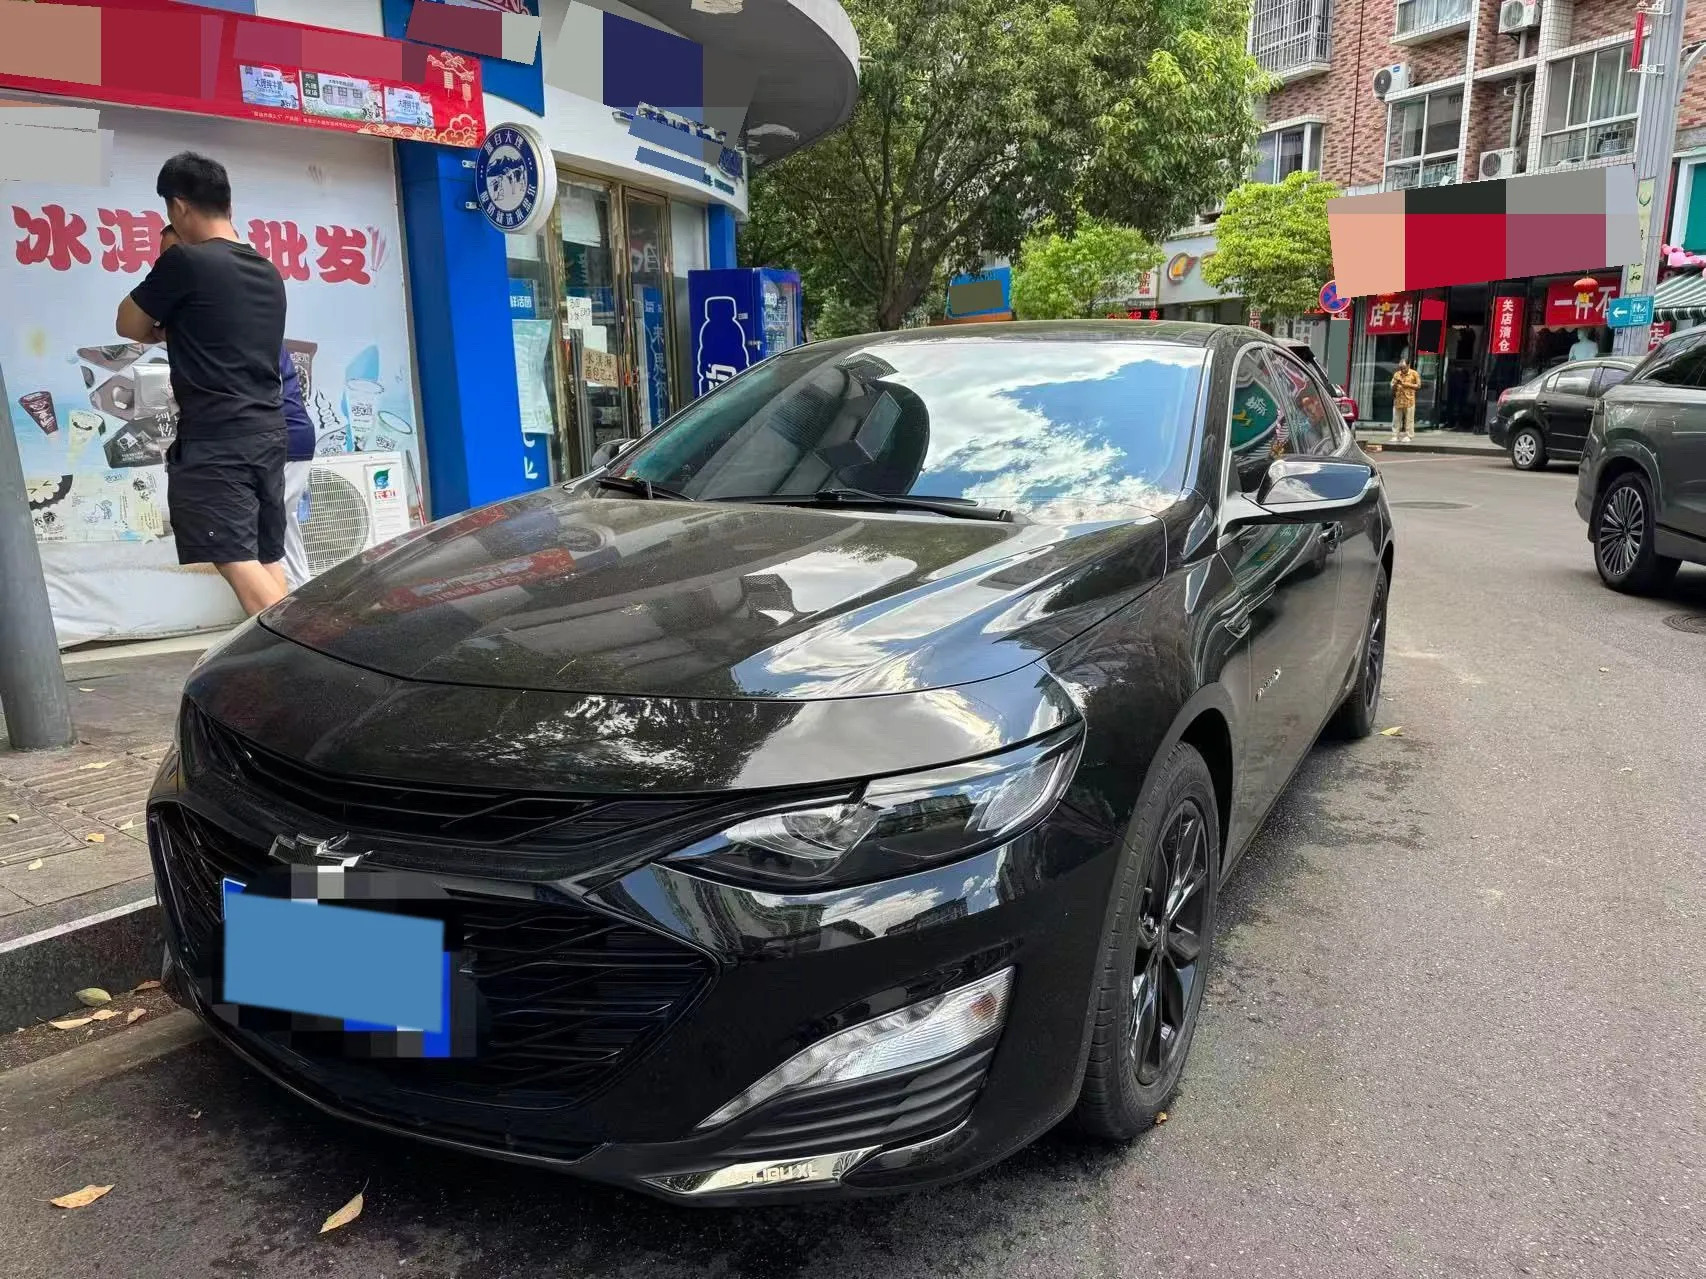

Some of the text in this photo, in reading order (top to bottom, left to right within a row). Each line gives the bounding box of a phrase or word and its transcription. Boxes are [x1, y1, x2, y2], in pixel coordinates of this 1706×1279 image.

[11, 203, 371, 286] 冰淇批发
[1498, 300, 1515, 352] 关店清仓
[796, 1163, 819, 1179] XL
